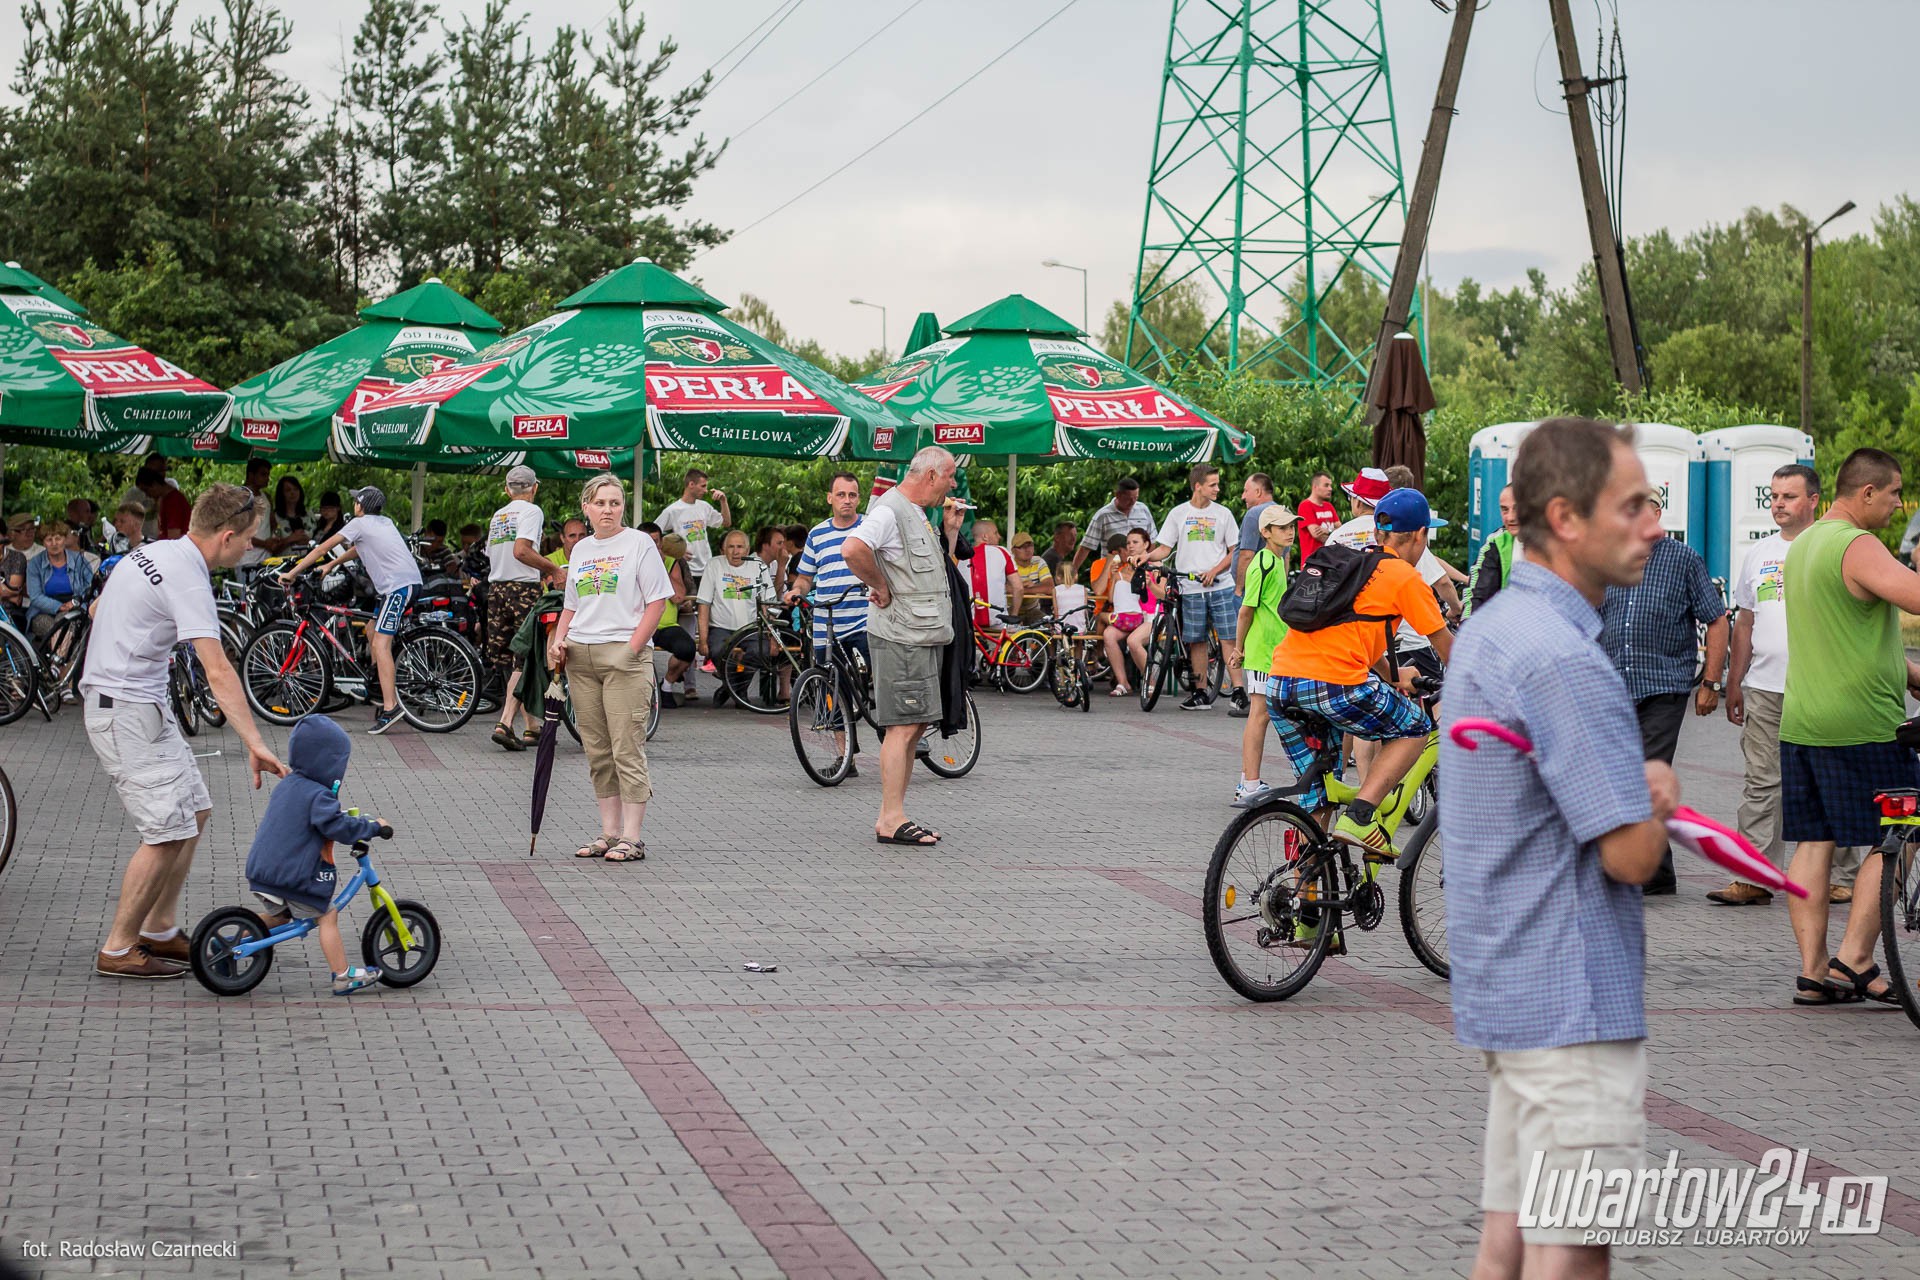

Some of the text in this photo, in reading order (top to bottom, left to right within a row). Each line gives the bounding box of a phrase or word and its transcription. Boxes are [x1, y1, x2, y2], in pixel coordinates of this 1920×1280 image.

[60, 356, 195, 384] PERŁA
[646, 375, 816, 401] PERŁA
[123, 407, 192, 420] CHMIELOWA
[1048, 394, 1186, 420] PERŁA
[246, 423, 277, 434] PERŁA
[517, 419, 564, 433] PERŁA
[699, 425, 792, 443] CHMIELOWA
[875, 432, 892, 445] PERŁA
[938, 427, 981, 439] PERŁA
[1097, 437, 1173, 452] CHMIELOWA
[578, 453, 608, 465] PERŁA
[1755, 485, 1772, 497] TO
[1755, 497, 1772, 509] TO
